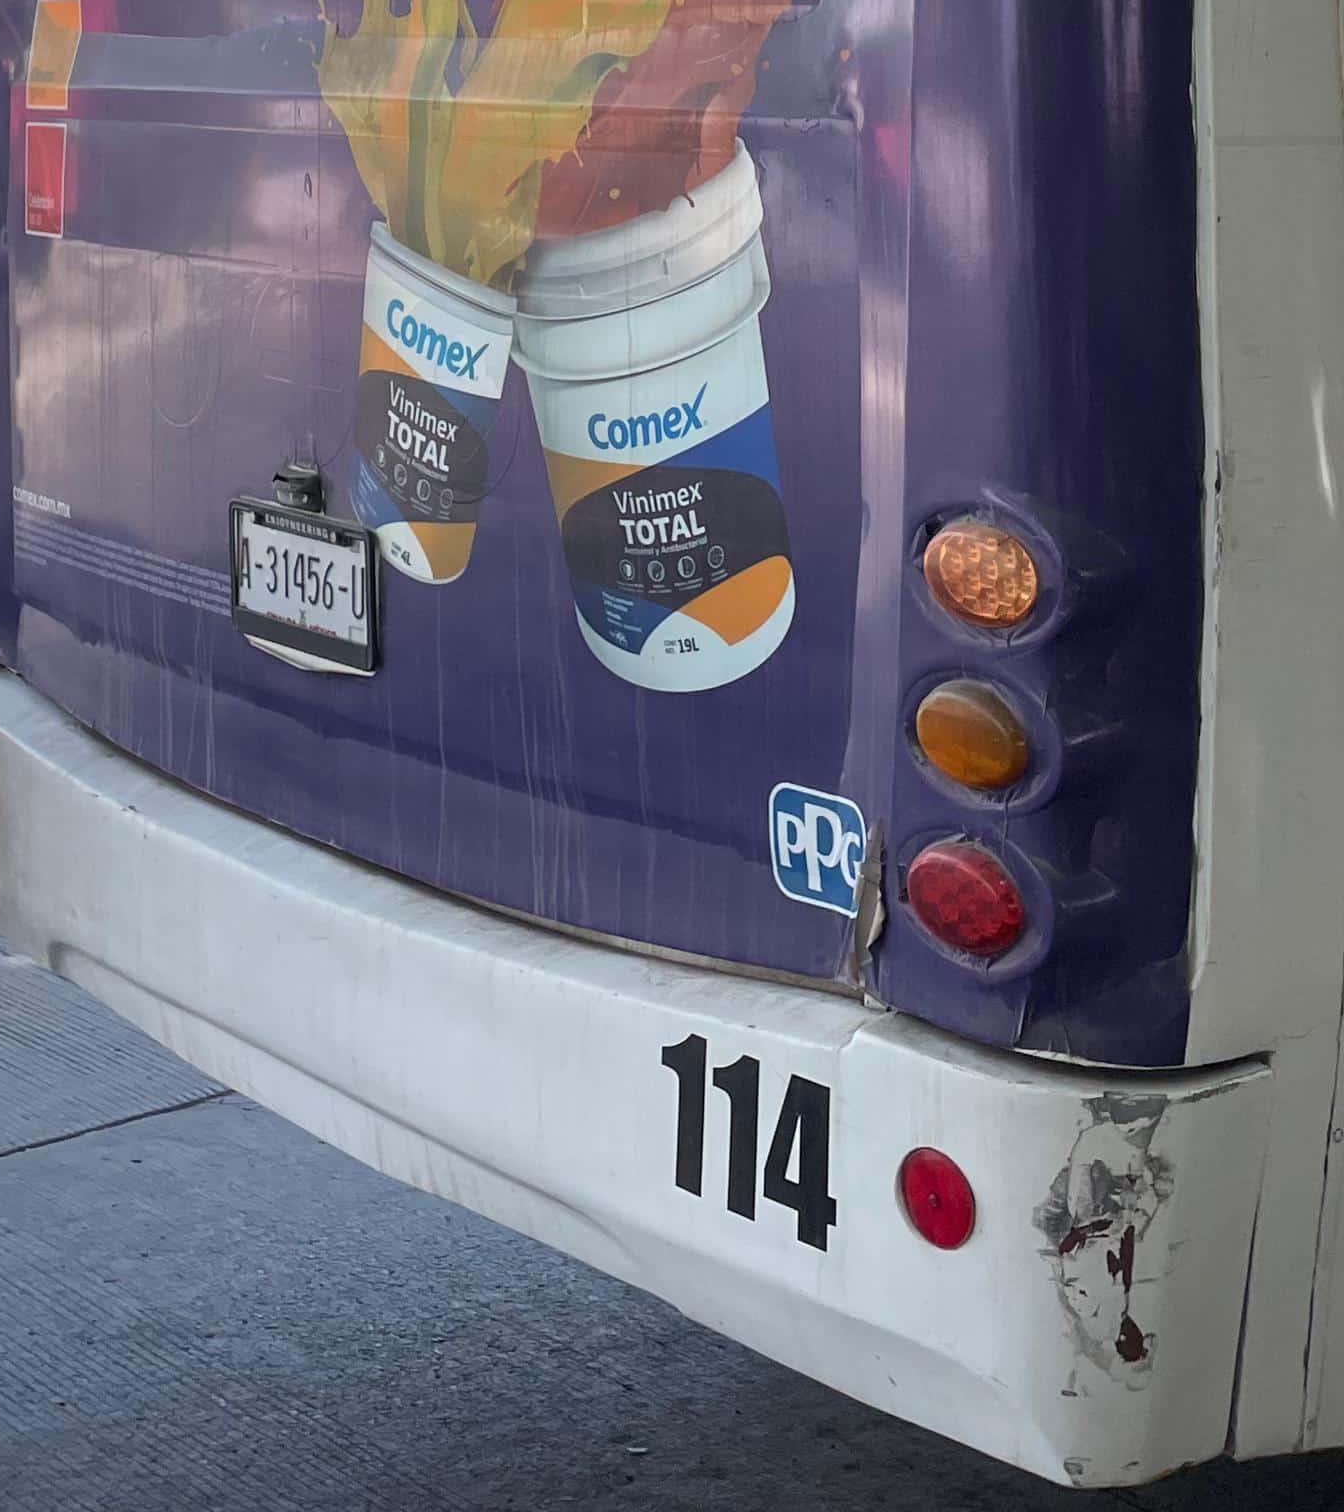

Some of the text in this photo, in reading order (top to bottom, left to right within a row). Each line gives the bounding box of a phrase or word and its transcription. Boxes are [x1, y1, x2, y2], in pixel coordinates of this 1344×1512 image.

[386, 298, 489, 381] Comex
[387, 410, 449, 472] TOTAL
[389, 380, 457, 442] Vinimex
[588, 381, 708, 450] Comex
[613, 482, 703, 515] Vinimex
[619, 510, 706, 545] TOTAL
[678, 637, 700, 654] 19L
[777, 802, 862, 892] PPG
[661, 1033, 837, 1253] 114
